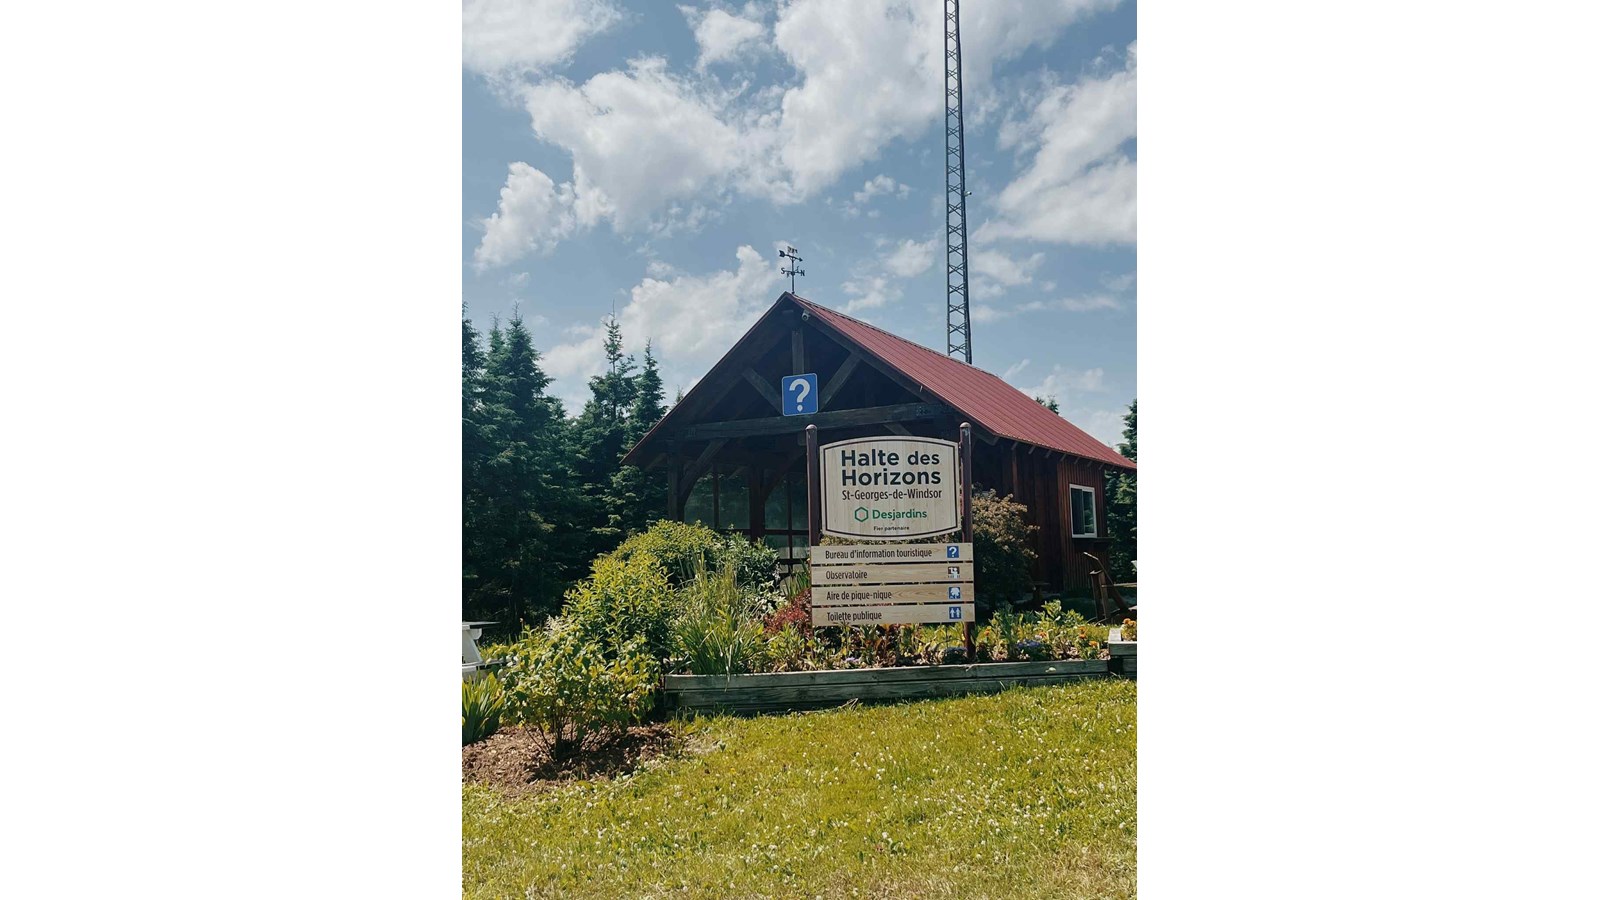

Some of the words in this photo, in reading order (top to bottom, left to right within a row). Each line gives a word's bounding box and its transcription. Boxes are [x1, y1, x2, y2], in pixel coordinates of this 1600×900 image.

[841, 449, 899, 466] Halte
[907, 451, 940, 465] des
[842, 468, 941, 486] Horizons
[842, 489, 942, 501] St-Georges-de-Windsor
[872, 509, 927, 520] Desjardins
[825, 550, 849, 559] Bureau
[850, 549, 896, 558] d'information
[896, 549, 933, 558] touristique
[825, 570, 868, 580] Observatoire
[826, 592, 840, 600] Aire
[841, 591, 850, 600] de
[851, 590, 892, 601] pique-nique
[827, 612, 852, 621] Toilette
[852, 611, 882, 622] publique
